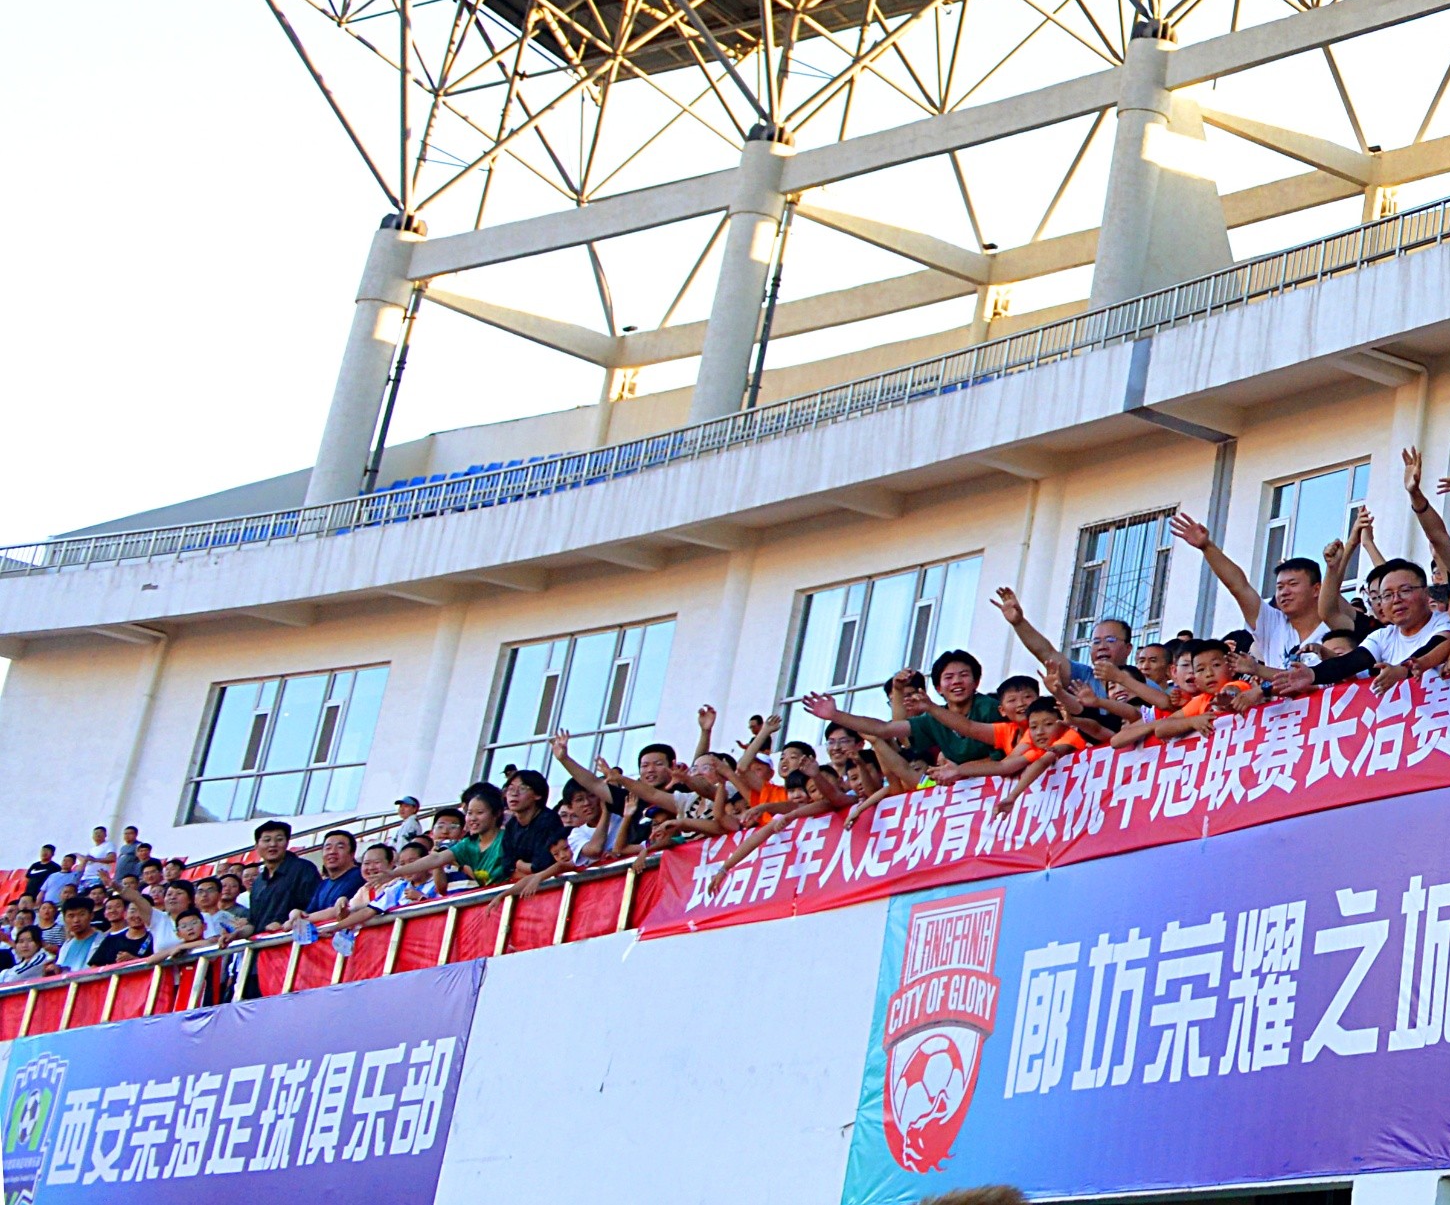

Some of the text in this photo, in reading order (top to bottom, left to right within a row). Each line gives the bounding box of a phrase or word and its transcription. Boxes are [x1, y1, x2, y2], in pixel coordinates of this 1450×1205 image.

[911, 913, 992, 977] LANGFANG
[888, 974, 997, 1035] CITY OF GLORY
[46, 1036, 457, 1185] 西安荣海足球俱乐部
